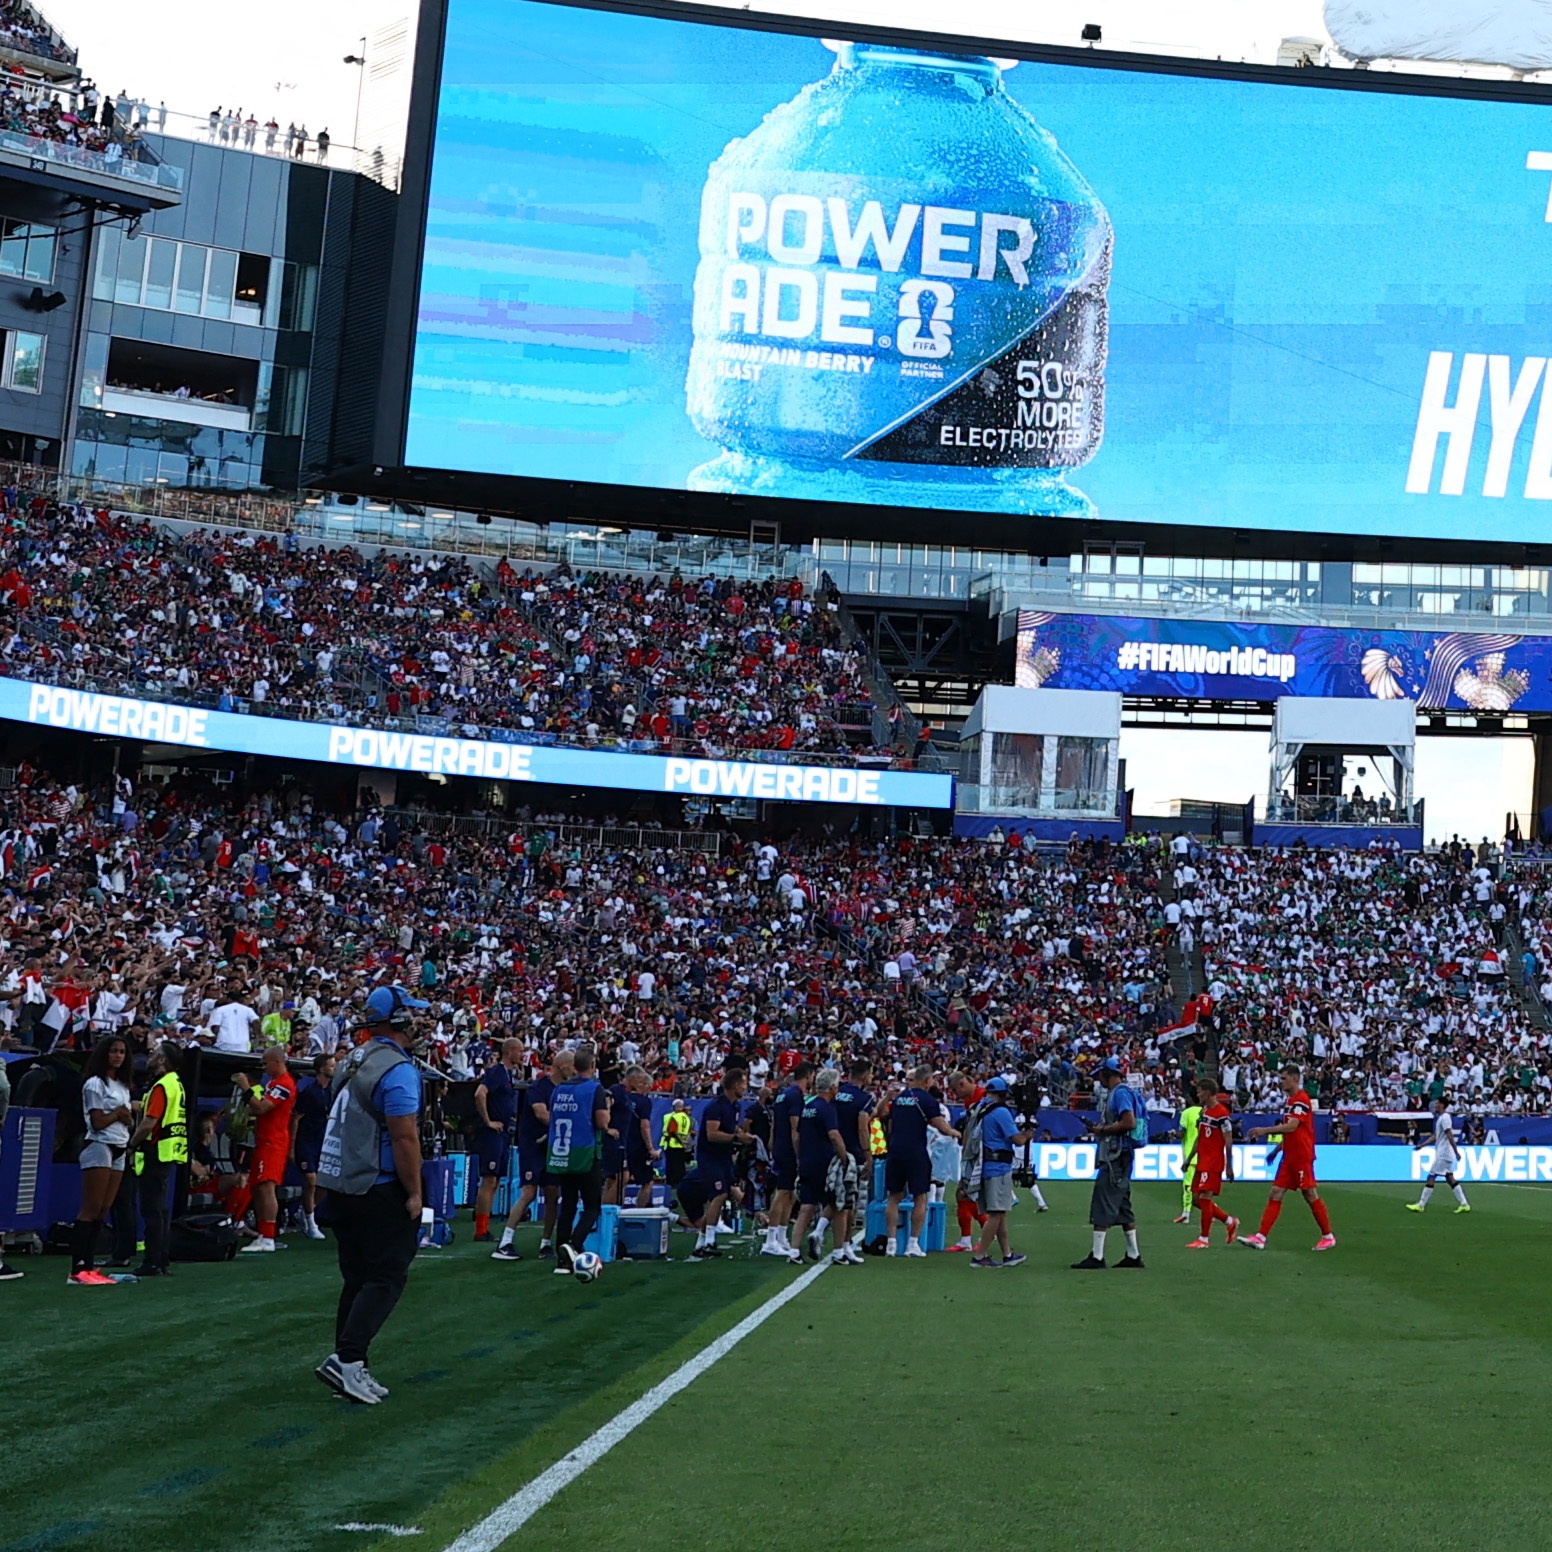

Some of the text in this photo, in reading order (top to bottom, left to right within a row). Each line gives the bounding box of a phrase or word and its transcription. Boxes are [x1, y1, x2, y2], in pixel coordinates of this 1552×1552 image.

[727, 192, 1037, 289] POWER
[720, 264, 878, 345] ADE
[805, 351, 875, 374] BERRY
[912, 342, 937, 351] FIFA
[900, 369, 944, 379] PARTNER
[901, 361, 944, 370] OFFICIAL
[1016, 360, 1084, 402] 50%
[1016, 401, 1082, 428] MORE
[1117, 641, 1296, 681] #FIFAWorldCup
[28, 682, 208, 746] POWERADE
[329, 726, 531, 781] POWERADE
[664, 757, 881, 803] POWERADE
[553, 1103, 578, 1112] PHOTO
[557, 1093, 575, 1102] FIFA
